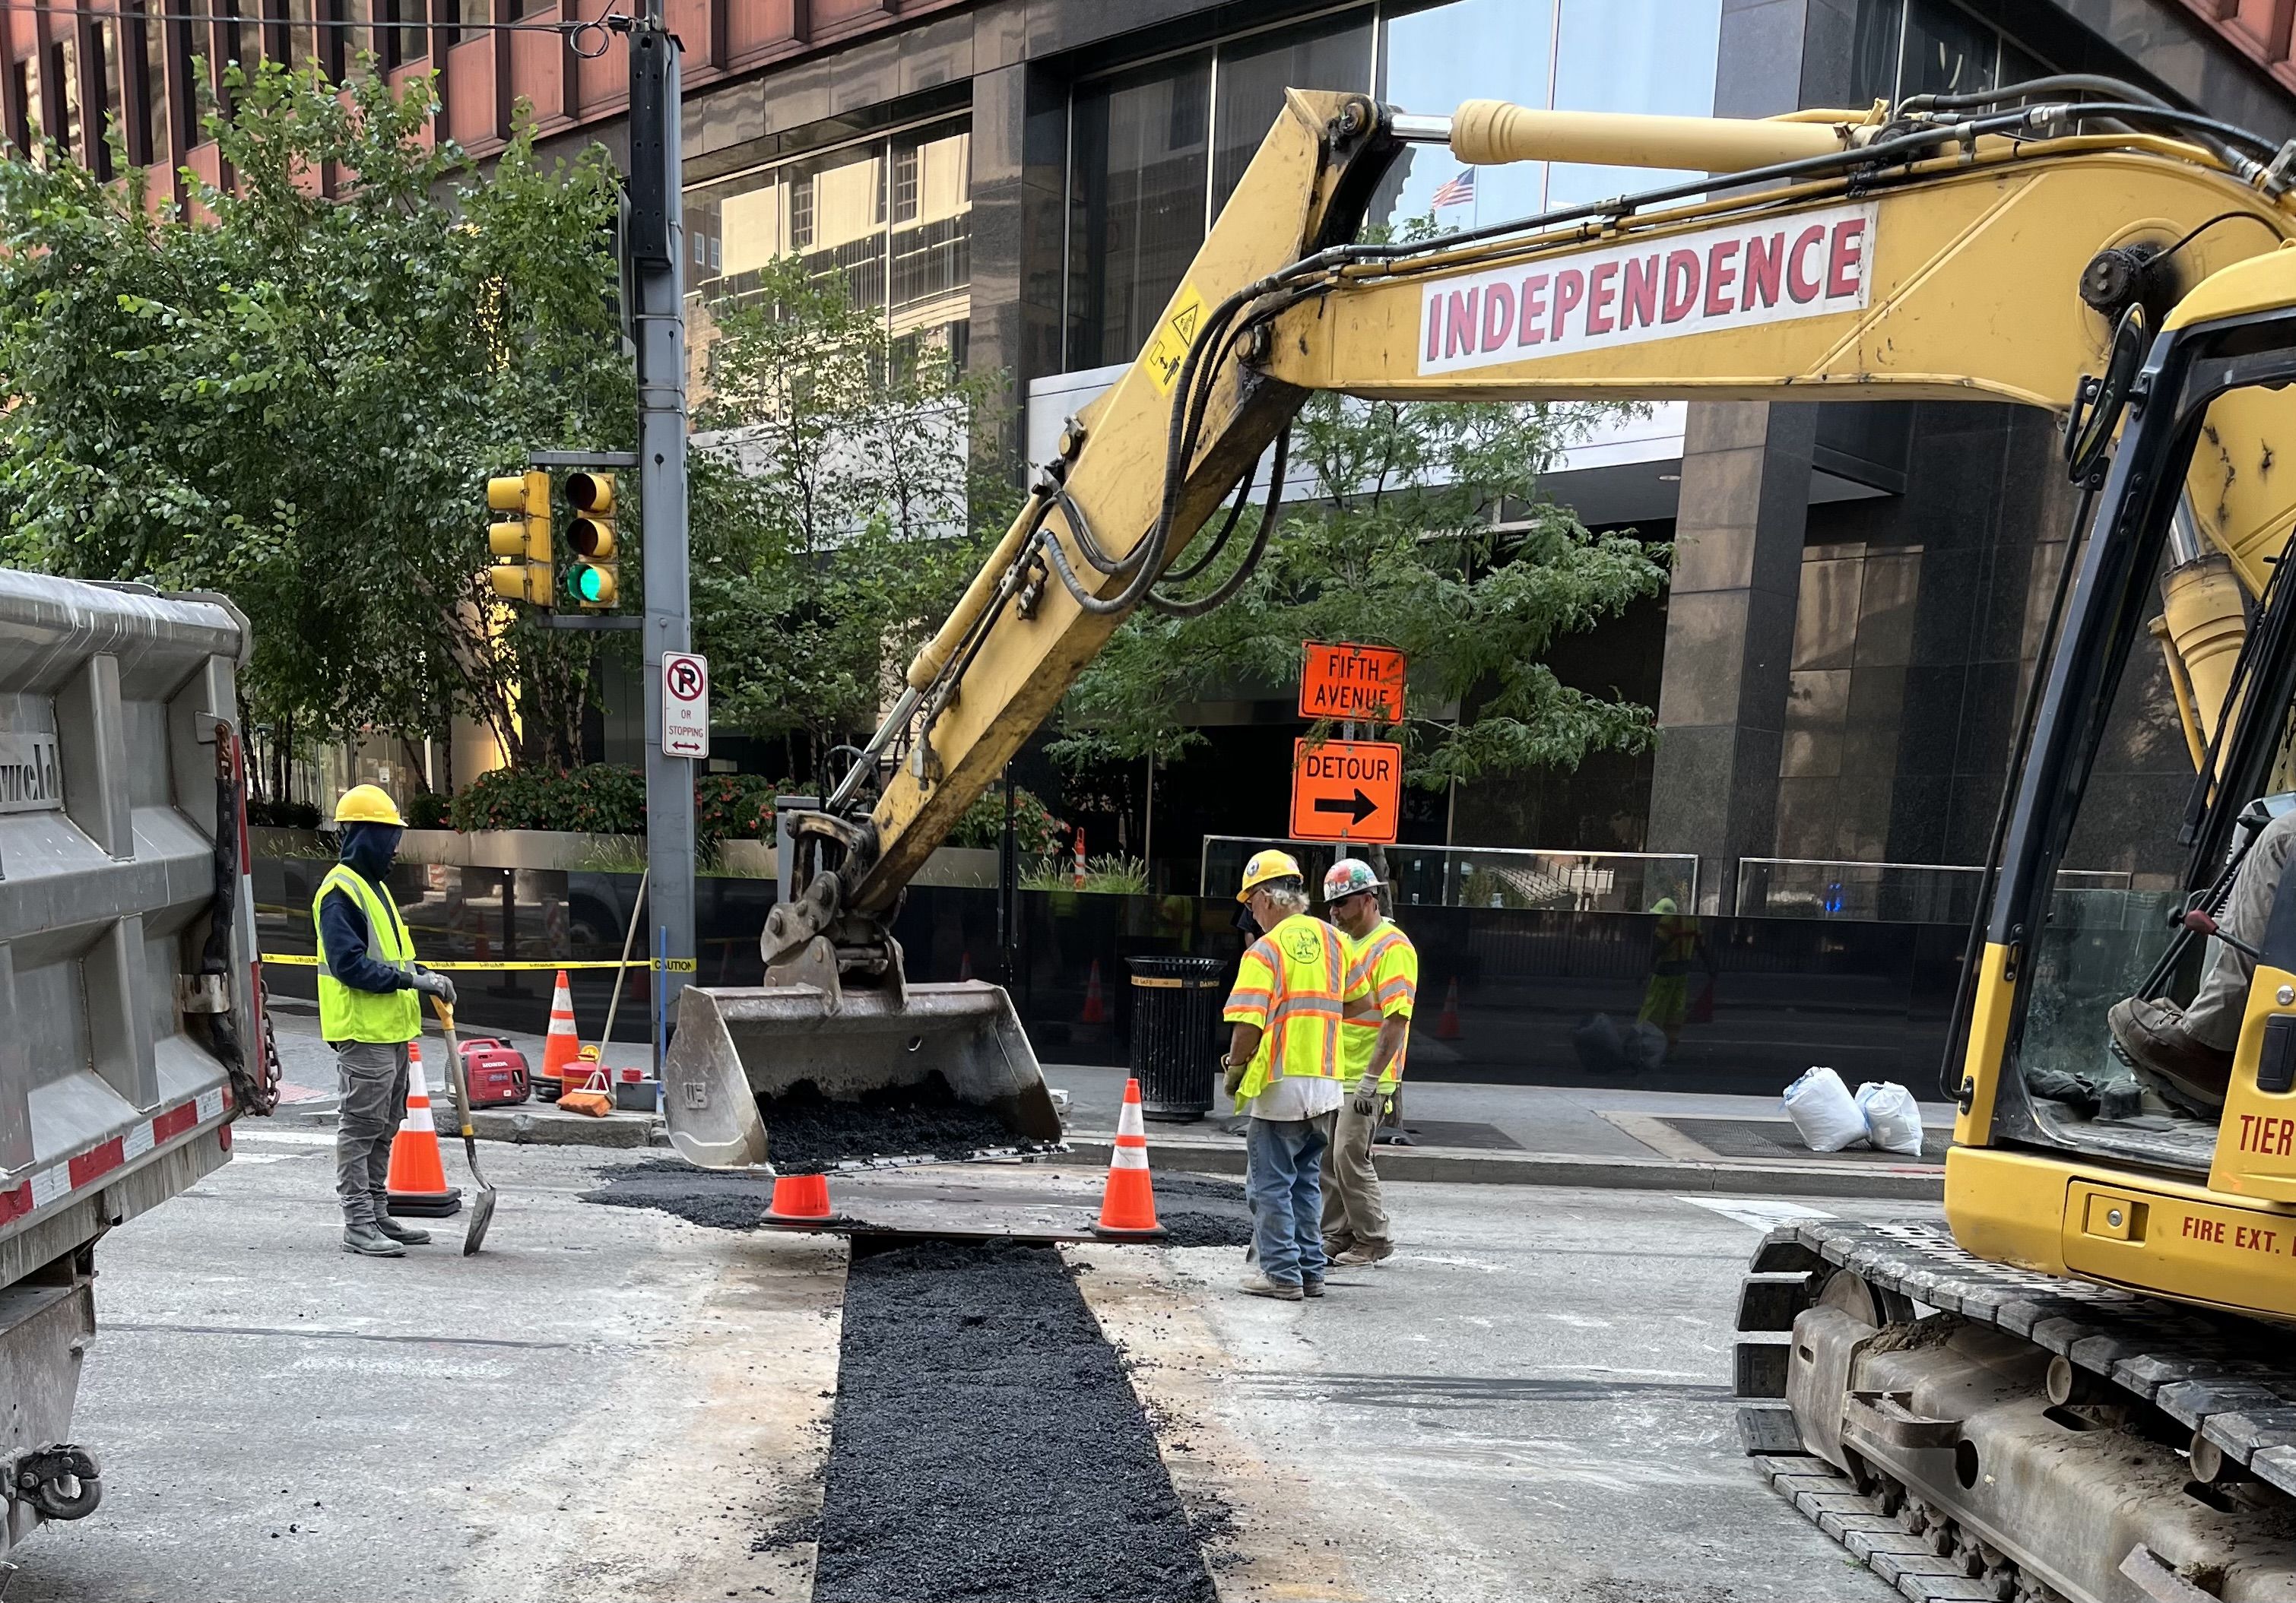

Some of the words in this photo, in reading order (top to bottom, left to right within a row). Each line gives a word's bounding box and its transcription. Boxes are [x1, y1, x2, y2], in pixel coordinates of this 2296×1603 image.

[1426, 217, 1866, 363] INDEPENDENCE
[1328, 654, 1380, 682] FIFTH
[1314, 683, 1390, 711] AVENUE
[680, 708, 692, 719] OR
[668, 725, 704, 738] STOPPING
[1306, 756, 1390, 781] DETOUR
[655, 959, 692, 971] CUTION
[2240, 1114, 2294, 1156] TIER
[2182, 1216, 2226, 1244] FIRE
[2234, 1225, 2280, 1254] EXT.
